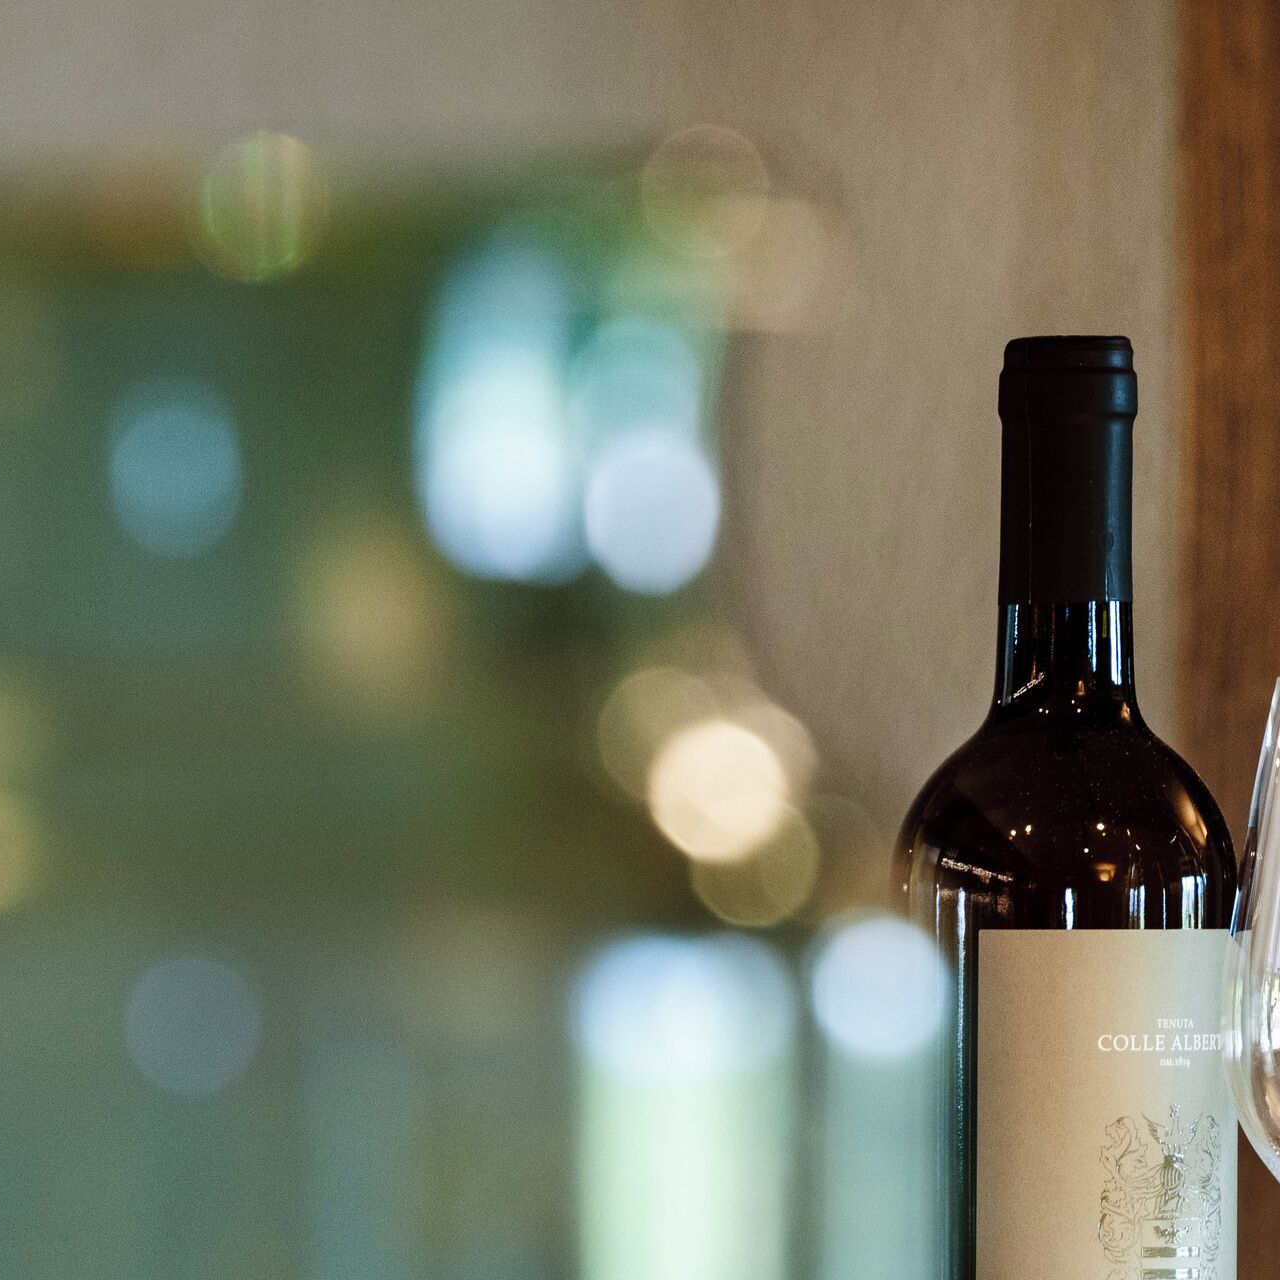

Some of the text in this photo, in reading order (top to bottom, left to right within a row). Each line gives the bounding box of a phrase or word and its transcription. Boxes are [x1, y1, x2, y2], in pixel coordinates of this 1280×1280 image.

[1157, 1018, 1194, 1029] TENUTA
[1097, 1033, 1222, 1052] COLLE ALBERT
[1160, 1056, 1191, 1069] DAL 1819
